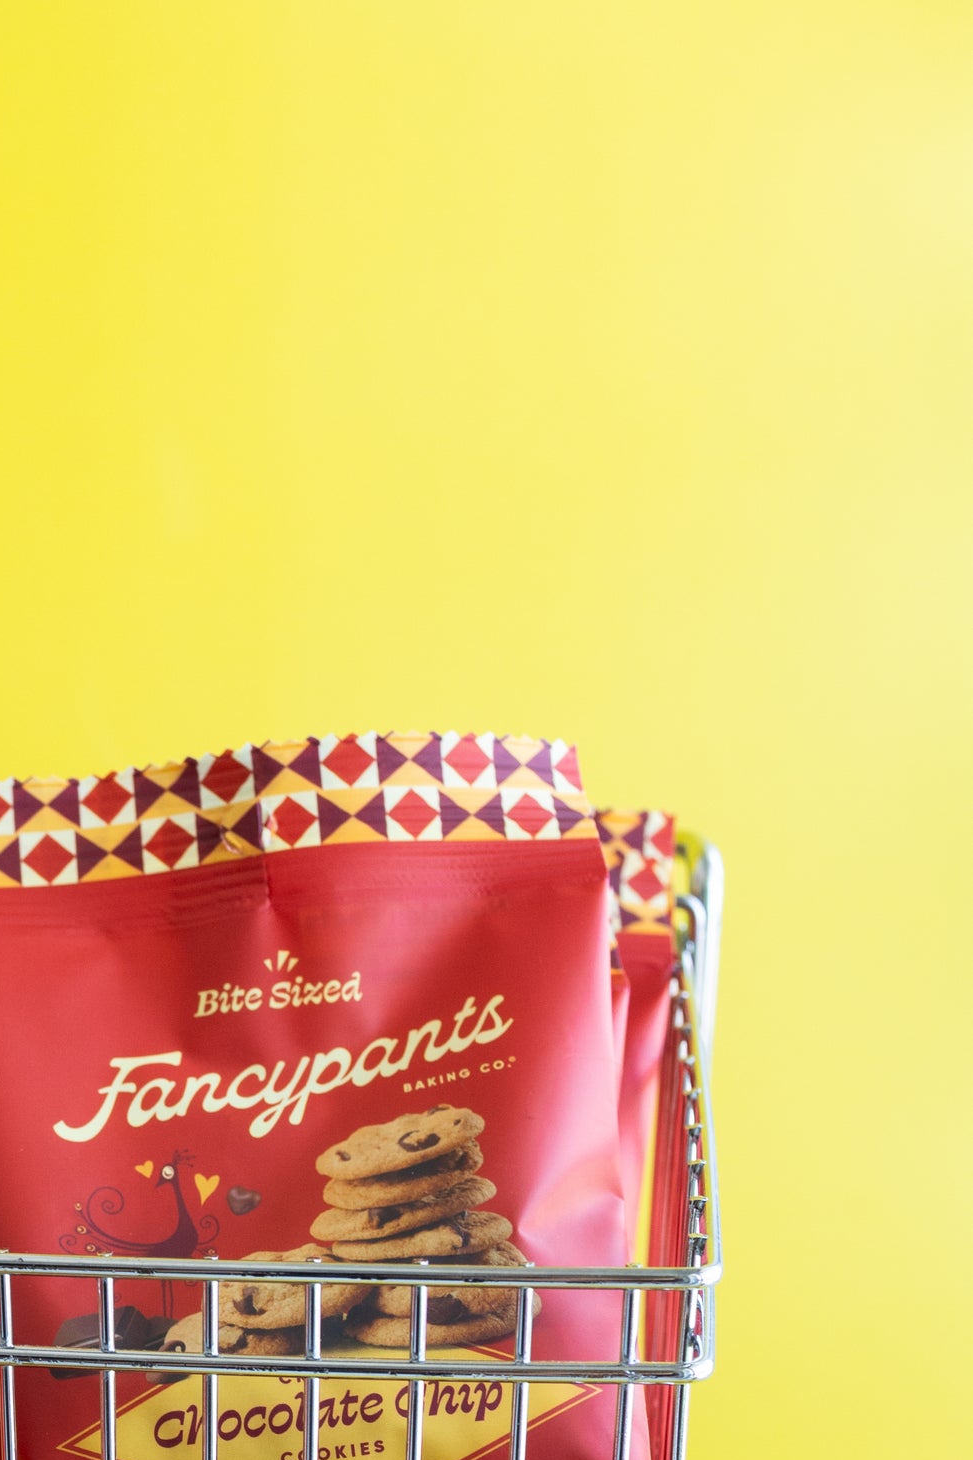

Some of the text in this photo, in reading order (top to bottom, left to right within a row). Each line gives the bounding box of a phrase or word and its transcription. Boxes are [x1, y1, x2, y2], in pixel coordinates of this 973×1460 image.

[193, 971, 363, 1018] Bite Sized
[53, 995, 514, 1142] Fancypants
[403, 1068, 470, 1093] BAKING
